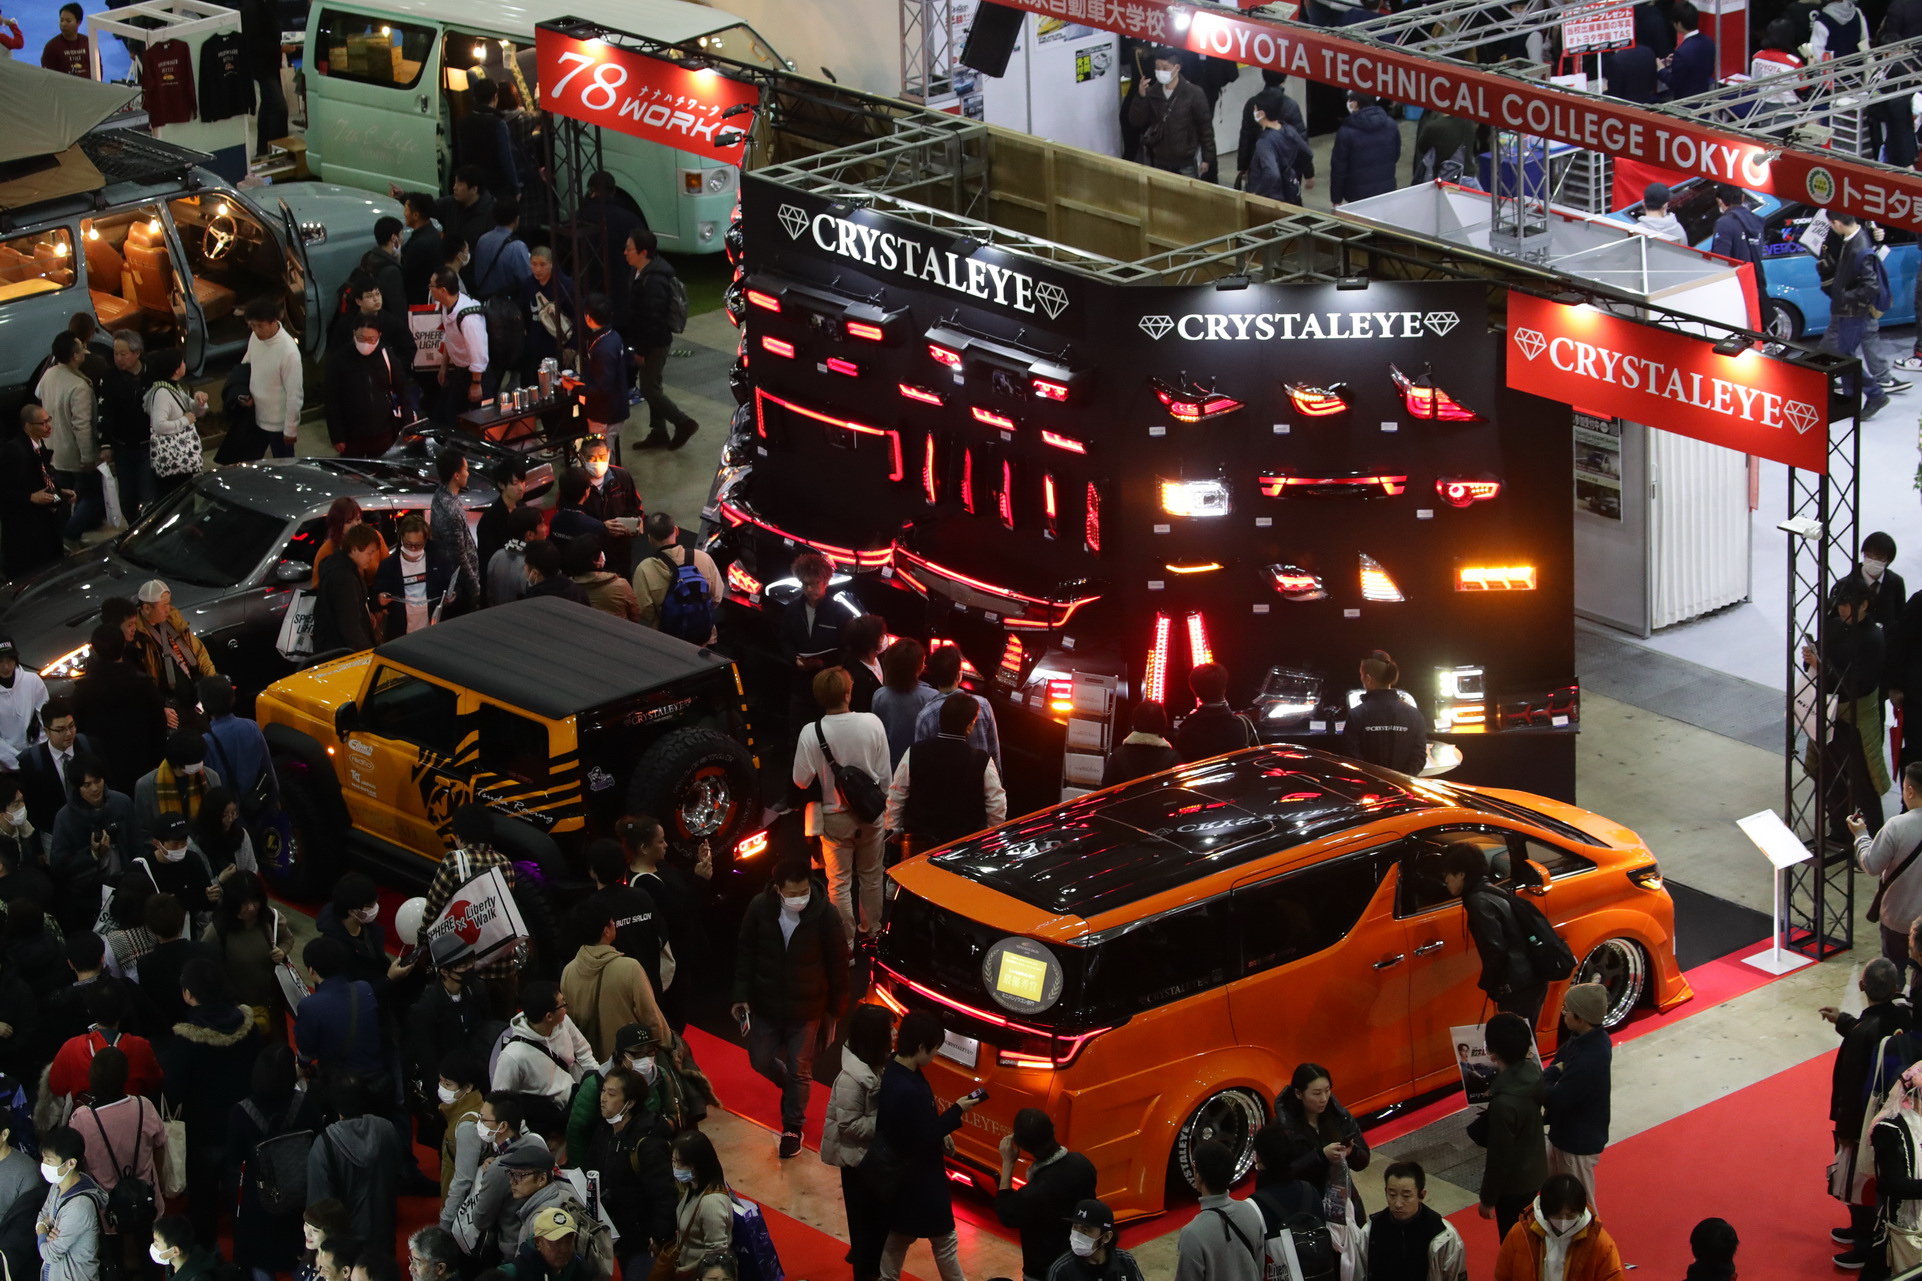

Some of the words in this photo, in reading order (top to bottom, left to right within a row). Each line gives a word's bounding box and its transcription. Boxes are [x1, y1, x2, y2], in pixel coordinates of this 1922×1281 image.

[1010, 0, 1166, 39] 京自動車大学校
[1614, 30, 1631, 39] TAS
[551, 51, 628, 111] 78
[638, 85, 729, 120] ナナハチワーク
[1195, 20, 1311, 75] TOYOTA
[1322, 48, 1490, 119] TECHNICAL
[1501, 93, 1644, 157] COLLEGE
[1657, 129, 1769, 187] TOKYO
[812, 213, 1037, 315] CRYSTALEYE
[414, 330, 445, 341] SPHERE
[1177, 311, 1425, 342] CRYSTALEYE
[419, 340, 442, 350] LIGHT
[1549, 336, 1784, 430] CRYSTALEYE
[514, 800, 554, 825] Racing
[427, 916, 456, 943] SPHERE
[465, 896, 497, 919] Liberty
[473, 908, 497, 930] Walk
[615, 917, 632, 928] AUTO
[632, 912, 652, 924] SALON
[934, 1095, 1001, 1137] YSTLEYE
